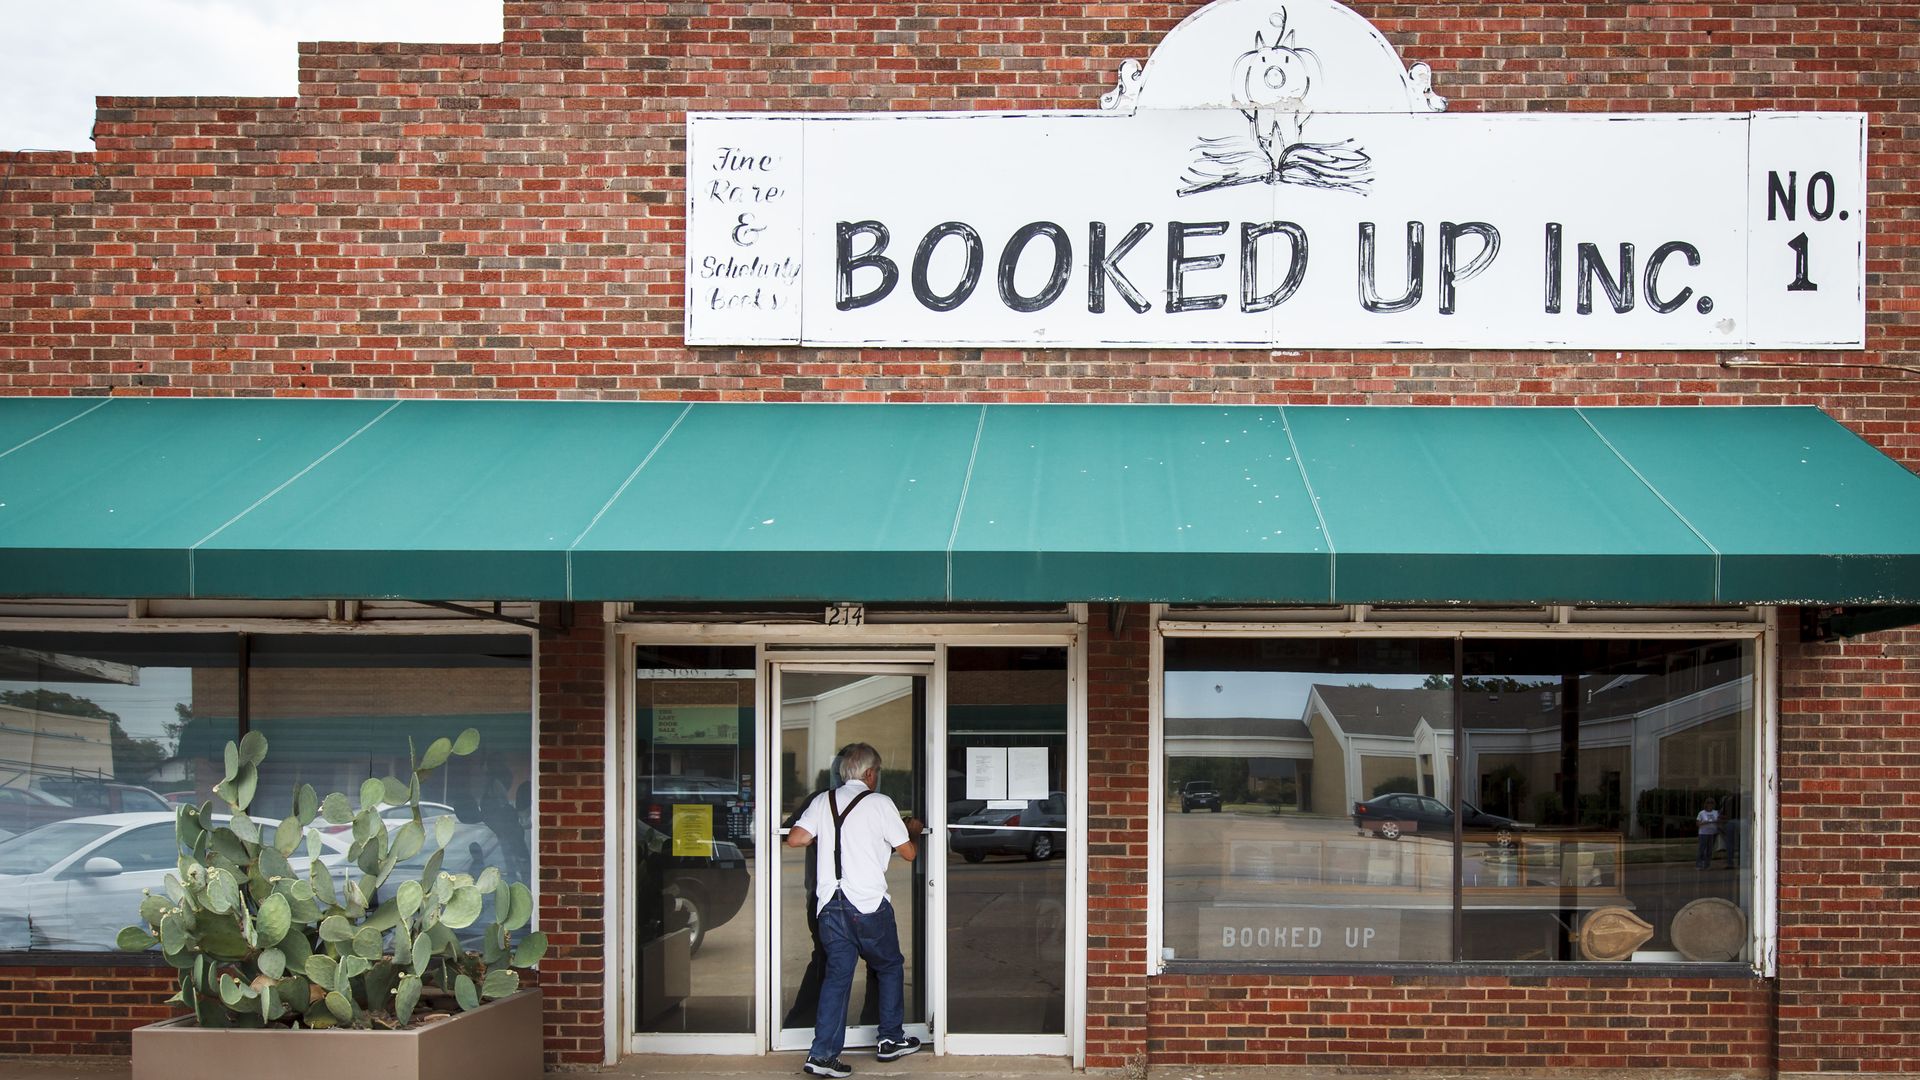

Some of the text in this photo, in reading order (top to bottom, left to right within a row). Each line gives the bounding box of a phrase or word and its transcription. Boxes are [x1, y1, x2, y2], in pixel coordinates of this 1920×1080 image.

[712, 147, 772, 172] Fine
[1766, 170, 1849, 221] NO.
[731, 212, 767, 247] &
[835, 220, 1308, 314] BOOKED
[1358, 220, 1501, 315] UP
[1786, 231, 1818, 292] 1
[828, 606, 862, 626] 214
[1222, 926, 1376, 948] BOOKED UP
